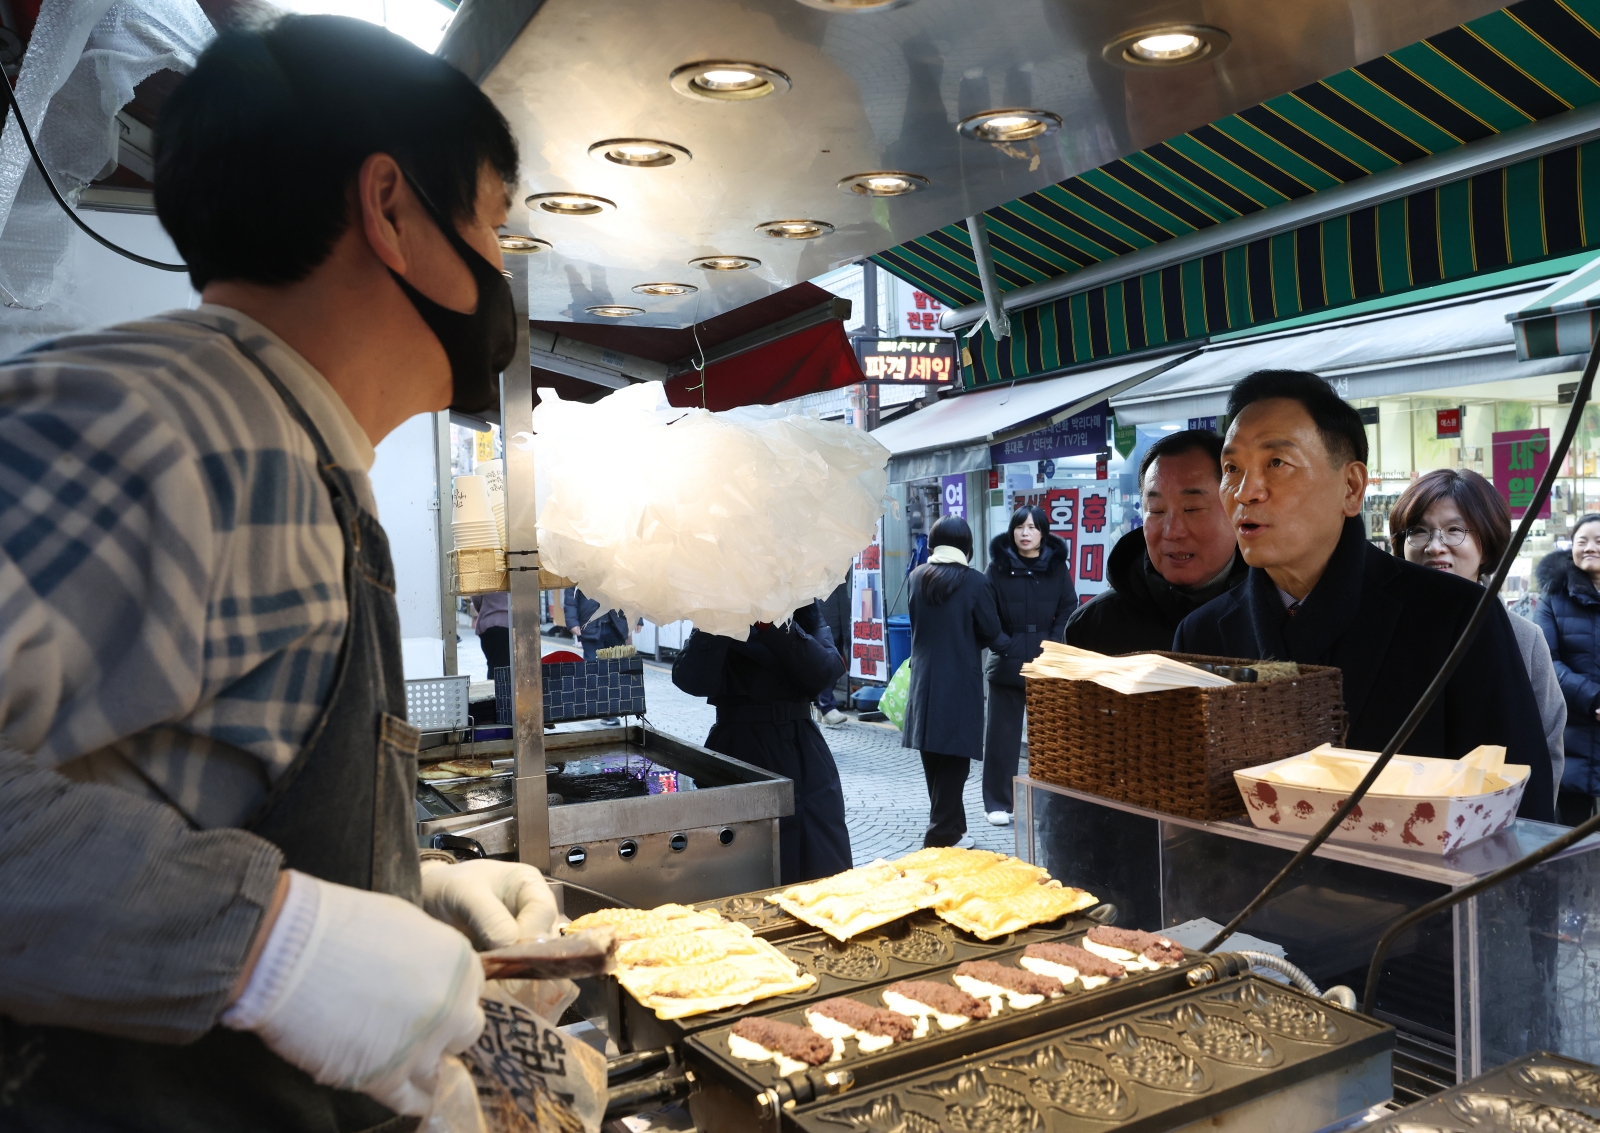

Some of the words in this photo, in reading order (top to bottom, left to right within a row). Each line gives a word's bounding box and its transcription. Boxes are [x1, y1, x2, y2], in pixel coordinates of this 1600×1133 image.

[906, 311, 940, 330] 전문
[908, 356, 951, 381] 세일
[1071, 414, 1101, 430] 박리다매
[1004, 440, 1024, 455] 휴대폰
[1032, 436, 1053, 451] 인터넷
[1063, 432, 1088, 447] TV가입
[1507, 441, 1536, 507] 세일
[1079, 493, 1107, 607] 휴대
